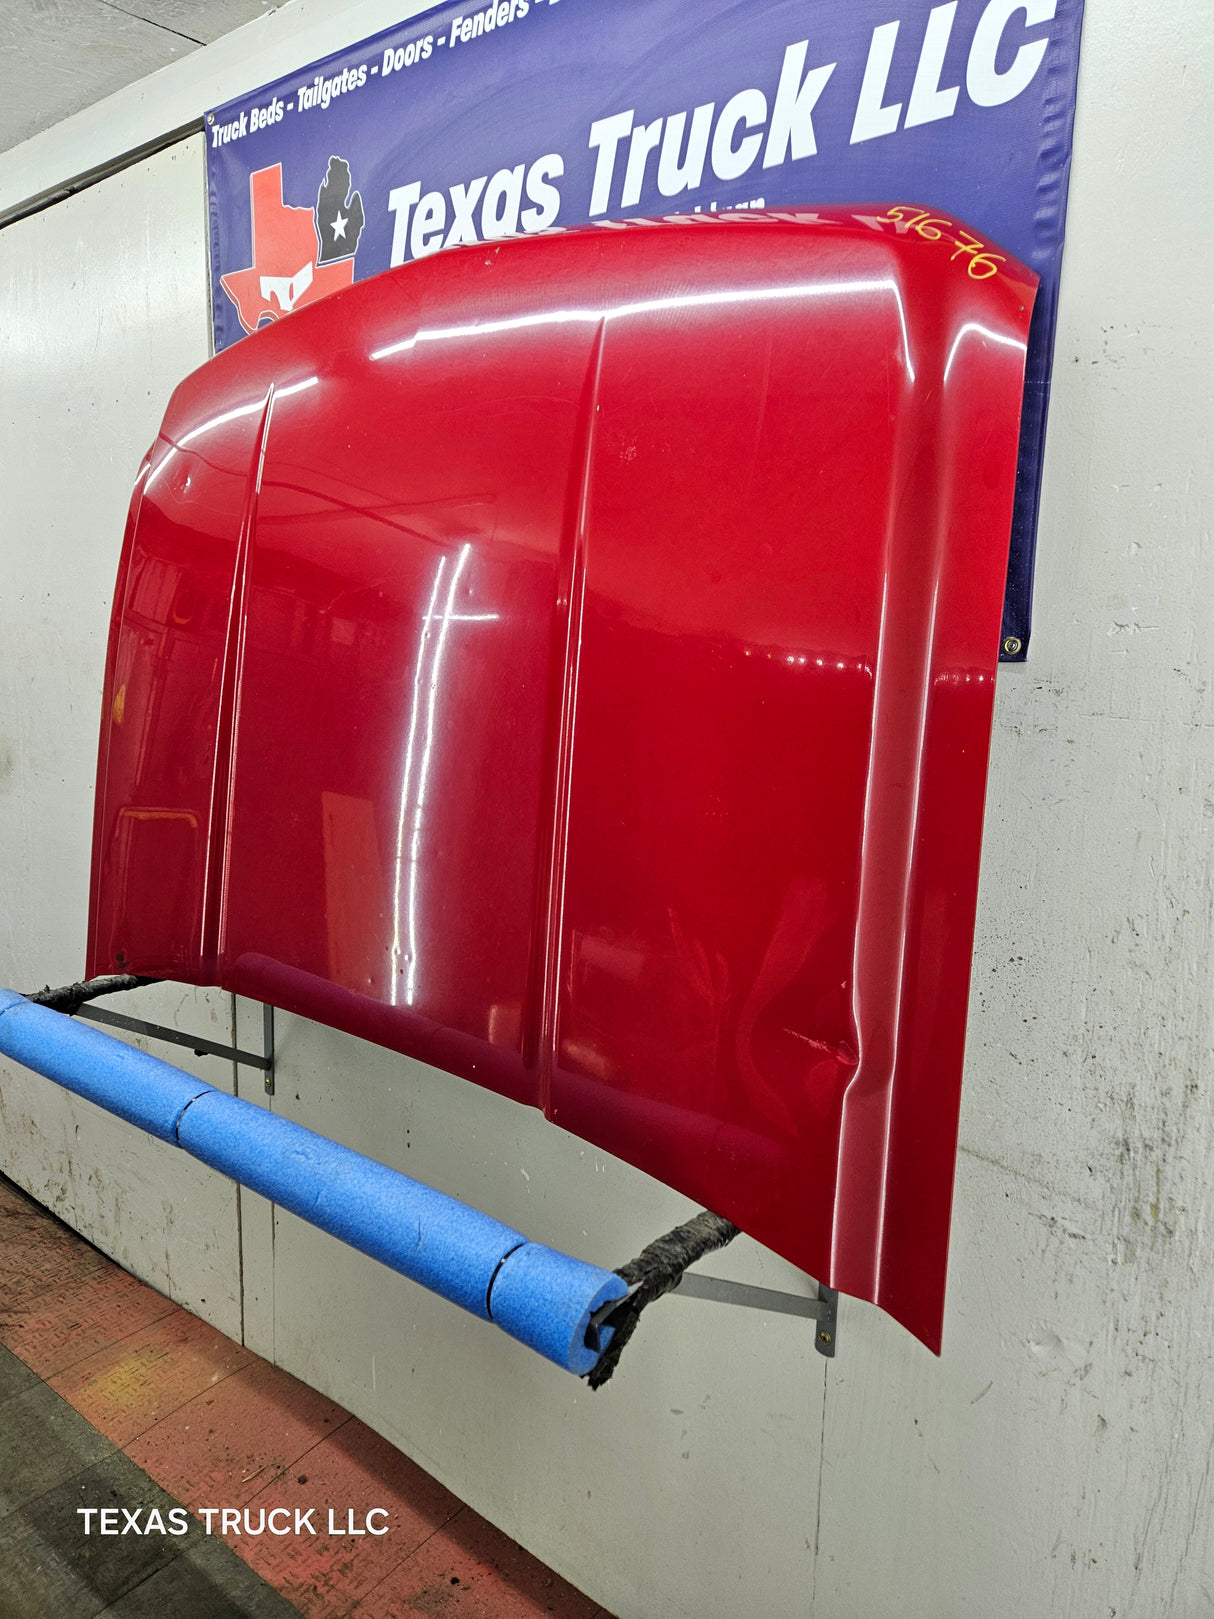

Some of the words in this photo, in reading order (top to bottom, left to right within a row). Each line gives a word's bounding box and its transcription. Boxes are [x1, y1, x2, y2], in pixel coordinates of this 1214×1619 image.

[211, 112, 248, 148] Truck
[250, 97, 285, 134] Beds
[297, 64, 368, 113] Tailgates
[381, 35, 434, 77] Doors
[449, 0, 530, 48] Fenders
[387, 153, 565, 269] Texas
[588, 39, 838, 217] Truck
[849, 0, 1057, 145] LLC
